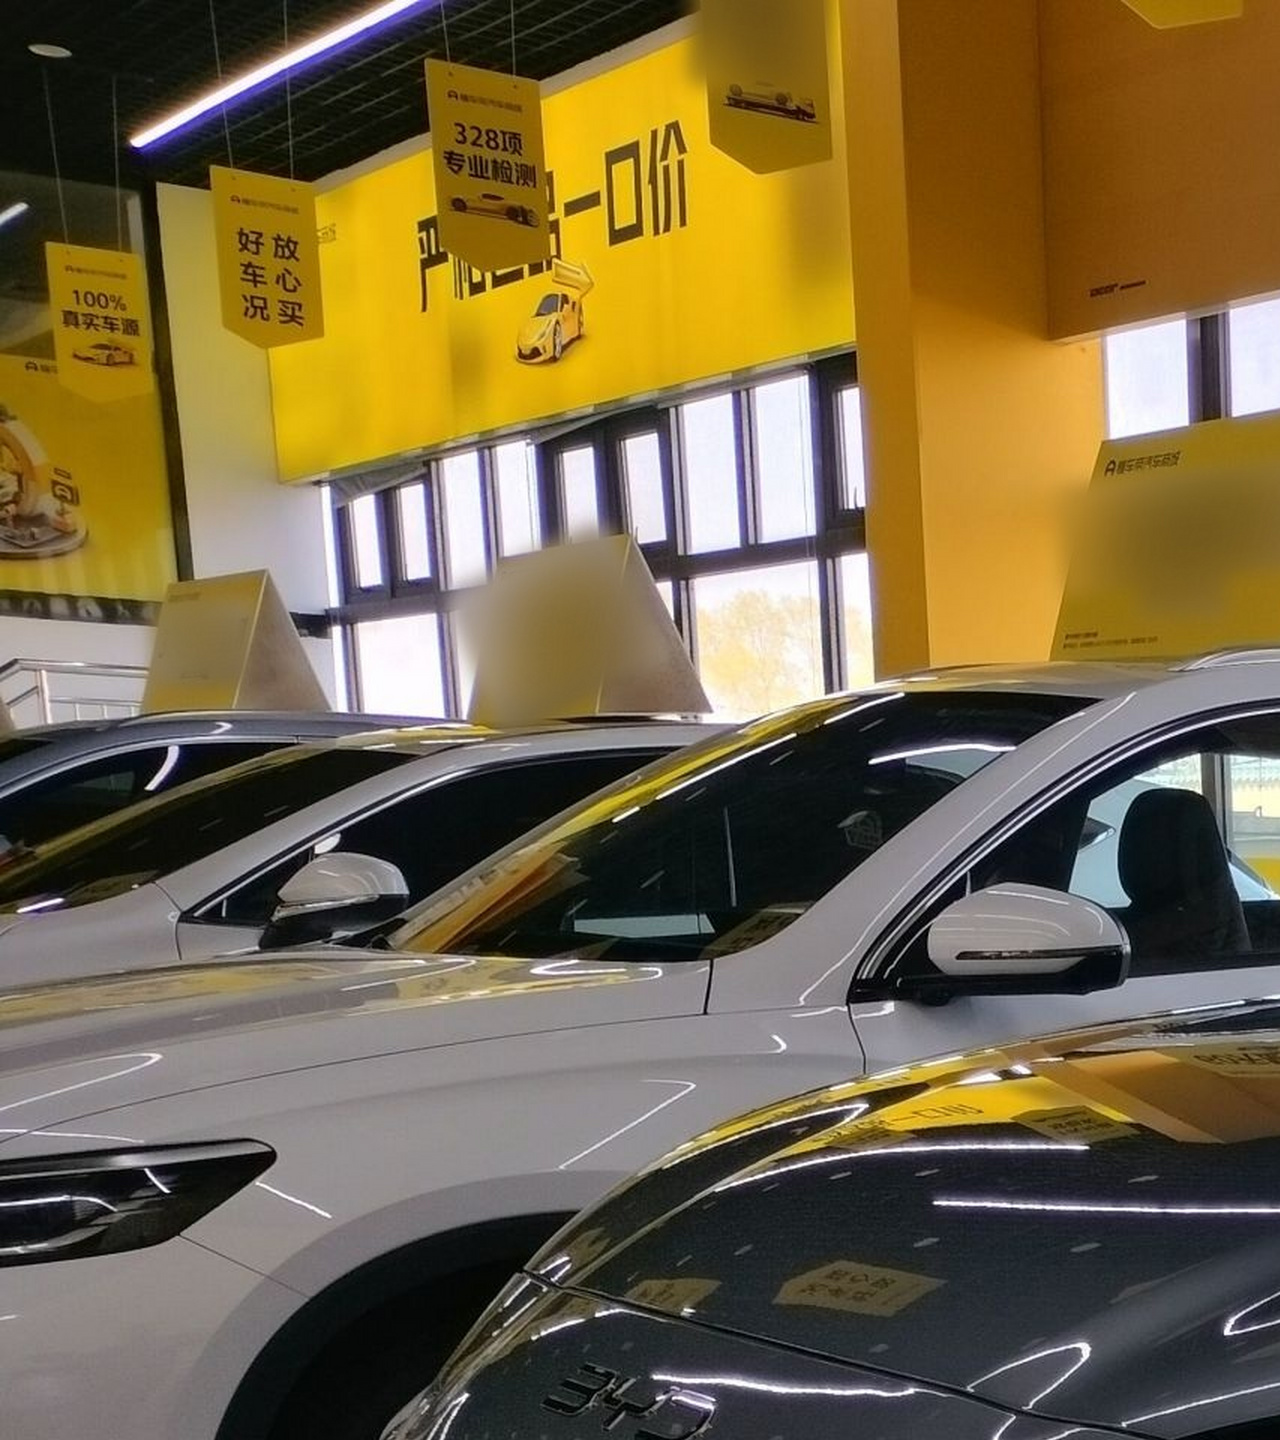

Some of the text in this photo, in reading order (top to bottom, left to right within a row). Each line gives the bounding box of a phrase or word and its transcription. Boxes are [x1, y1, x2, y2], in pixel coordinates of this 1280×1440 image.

[454, 122, 523, 156] 328项
[443, 150, 538, 188] 专业检测
[236, 227, 270, 322] 好车况
[271, 233, 304, 327] 放心买
[72, 289, 128, 312] 100%
[60, 309, 141, 337] 真实车源
